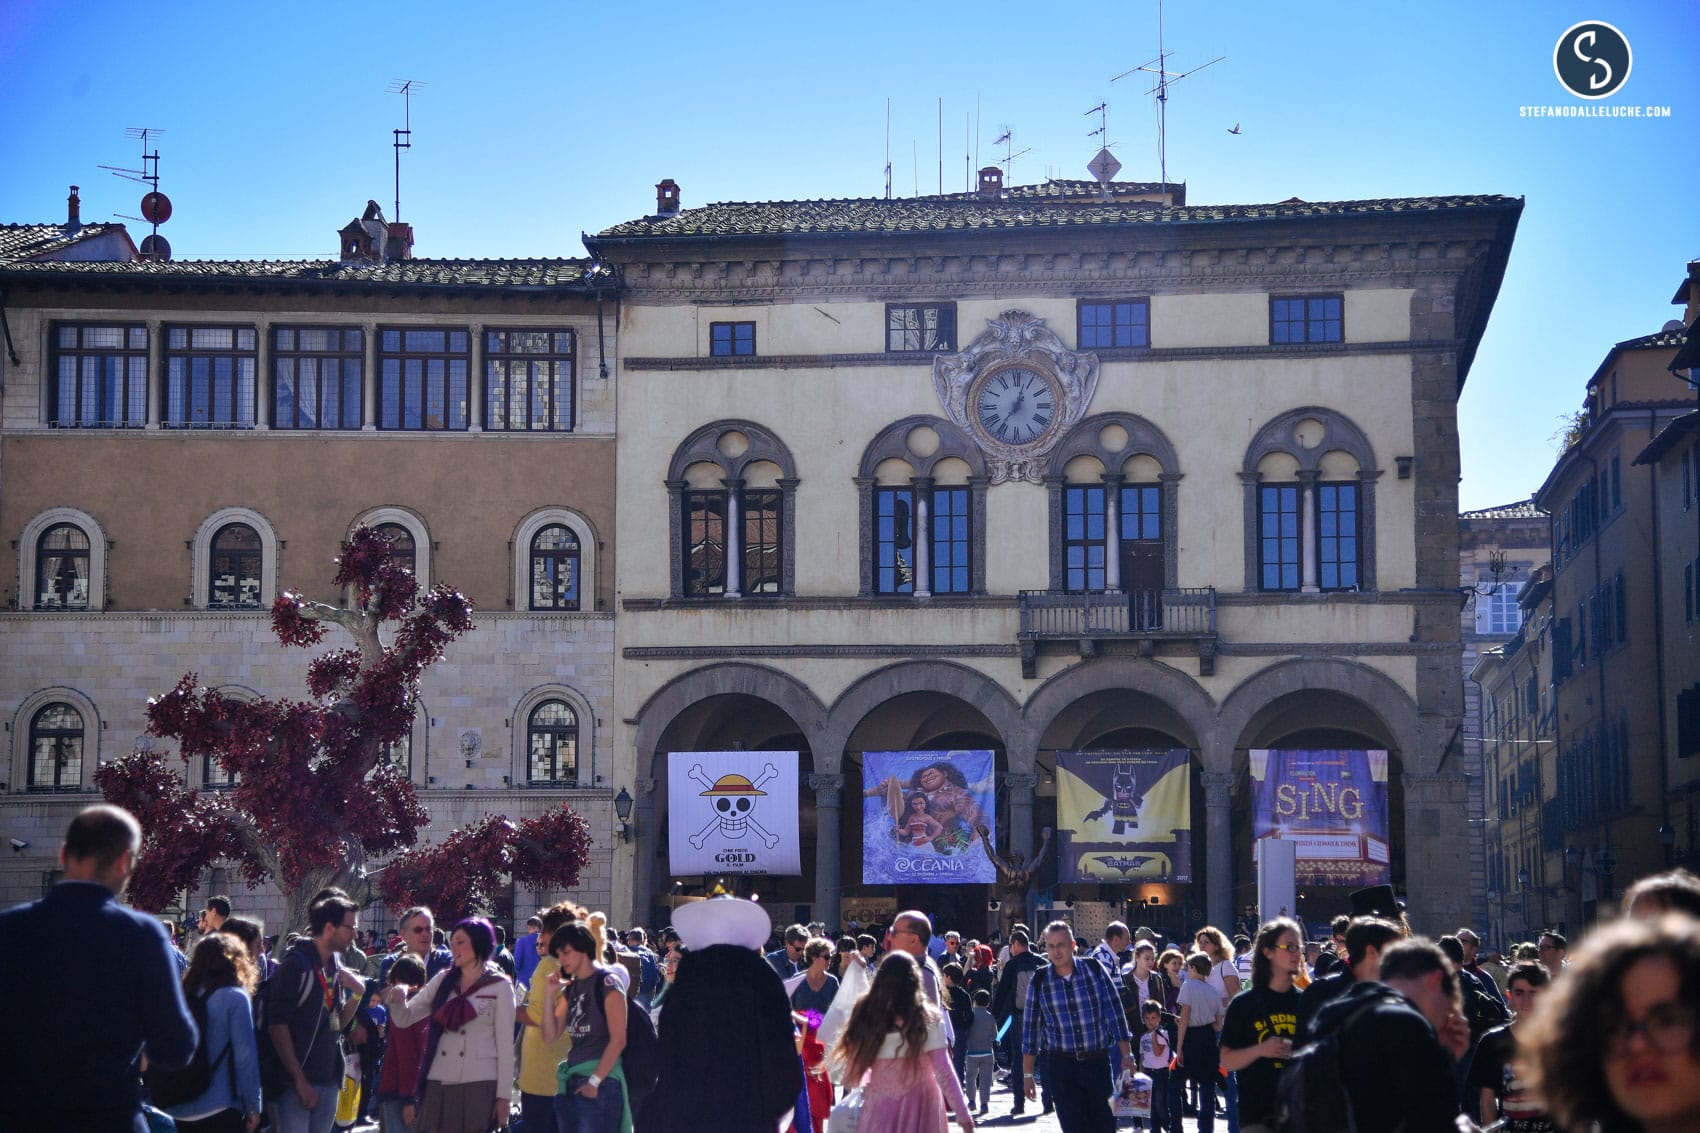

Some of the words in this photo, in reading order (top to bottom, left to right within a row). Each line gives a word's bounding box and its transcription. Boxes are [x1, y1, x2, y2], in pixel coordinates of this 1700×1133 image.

[1276, 782, 1364, 820] SING
[715, 853, 756, 863] GOLD
[894, 857, 964, 872] OCEANIA
